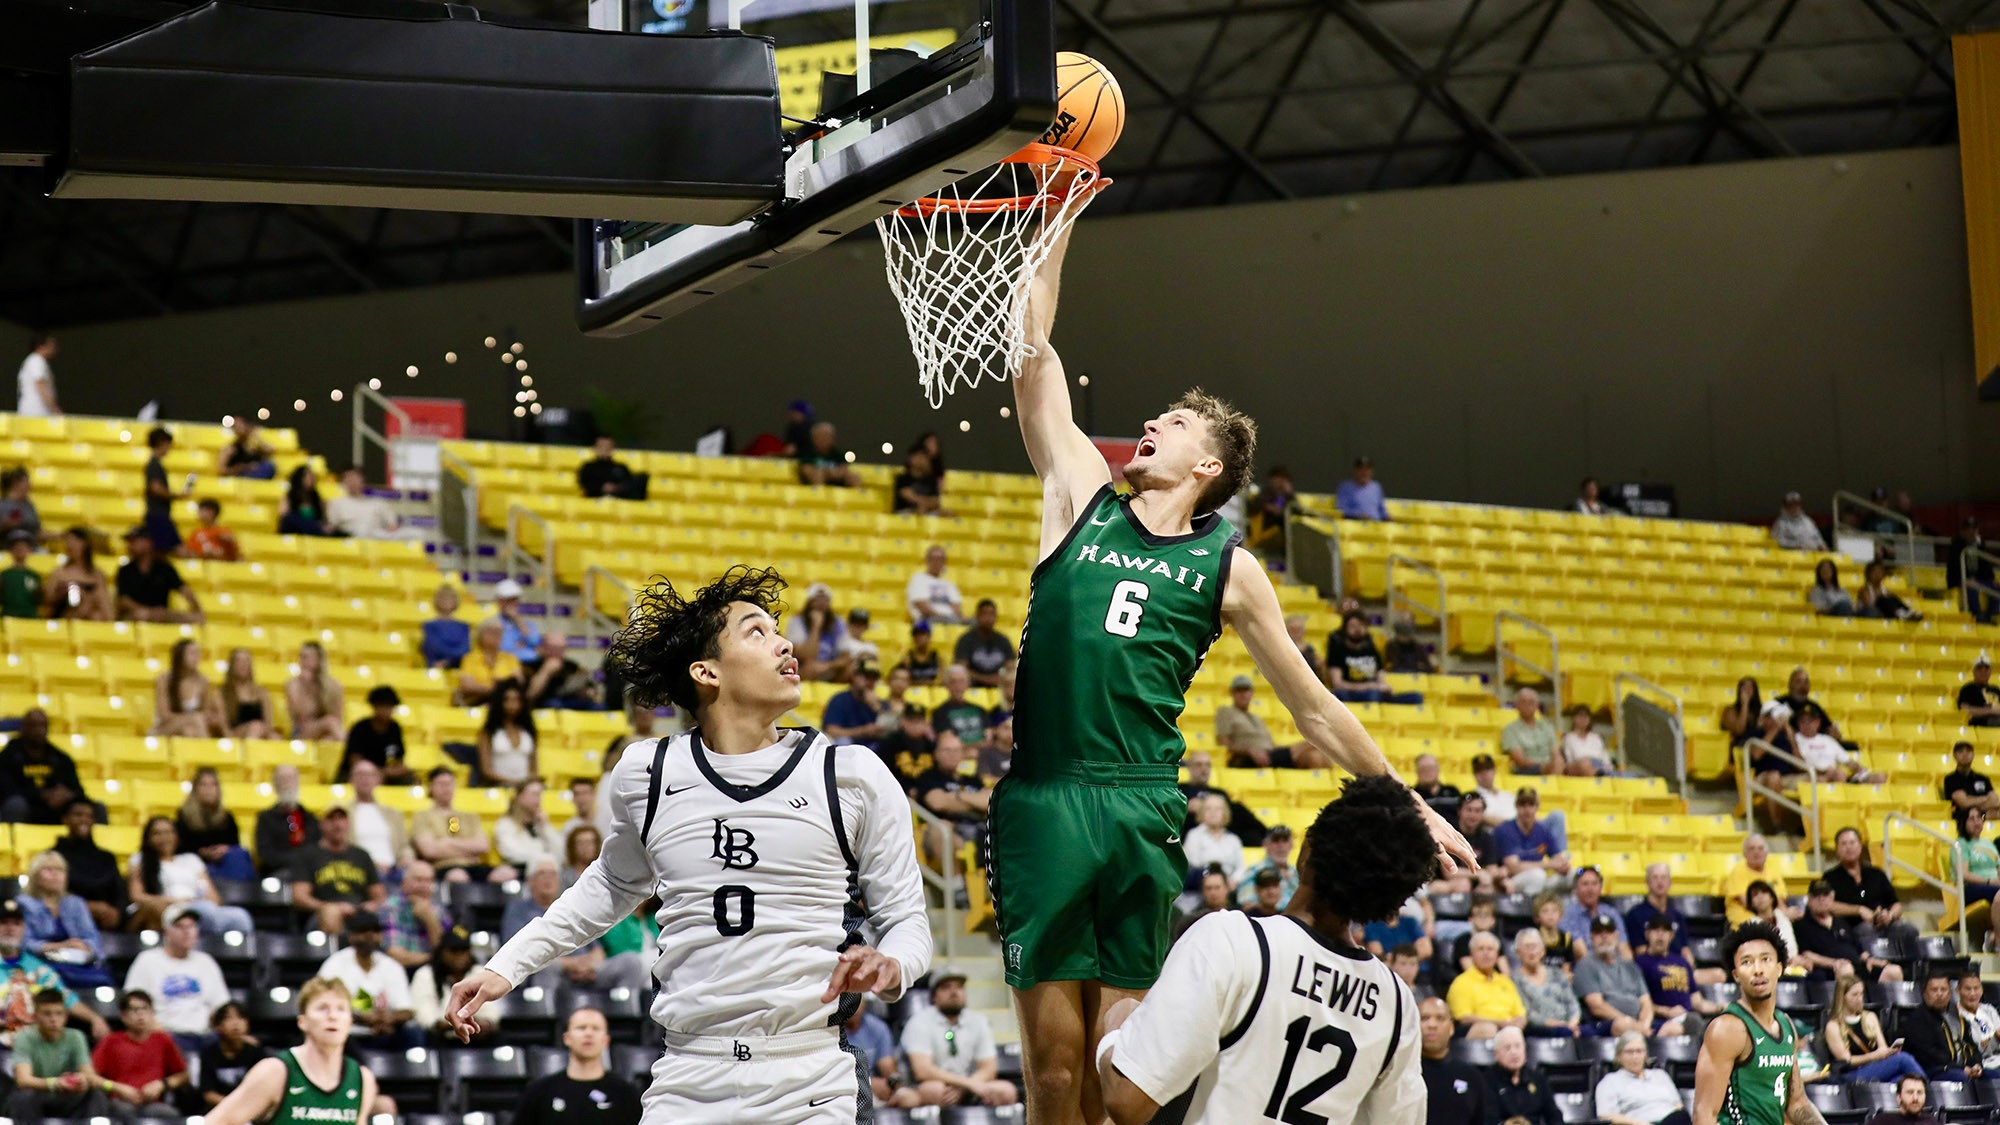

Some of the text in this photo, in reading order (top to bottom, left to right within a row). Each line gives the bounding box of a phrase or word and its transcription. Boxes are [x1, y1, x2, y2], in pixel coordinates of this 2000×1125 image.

[1038, 111, 1077, 145] CAA
[1105, 579, 1150, 638] 6
[709, 818, 759, 871] LB
[712, 885, 755, 936] 0
[1291, 954, 1380, 1021] LEWIS
[733, 1039, 752, 1061] LB
[1263, 1015, 1357, 1125] 12
[1773, 1072, 1786, 1106] 4
